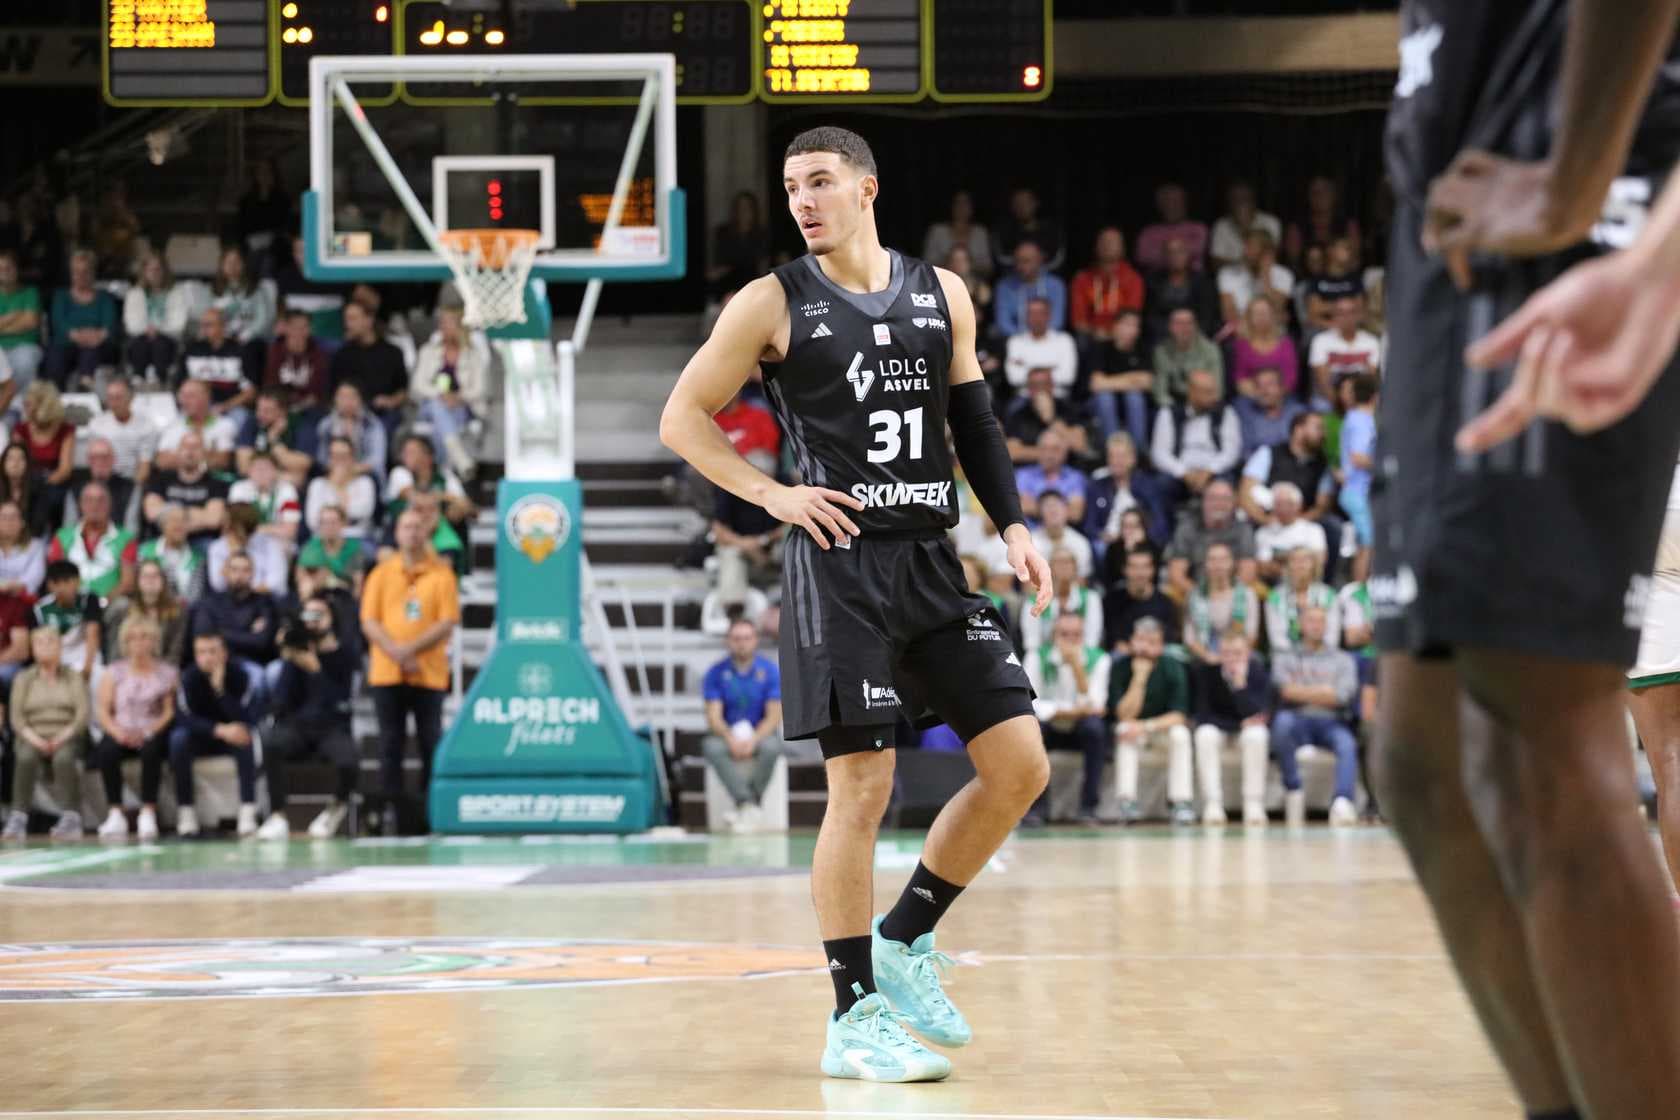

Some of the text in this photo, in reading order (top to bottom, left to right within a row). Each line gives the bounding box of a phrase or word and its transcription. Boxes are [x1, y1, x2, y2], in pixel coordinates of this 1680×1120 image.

[804, 307, 829, 317] CISCO
[879, 358, 927, 376] LDLC
[883, 377, 931, 392] ASVEL
[867, 407, 923, 463] 31
[851, 480, 952, 508] SKWEEK
